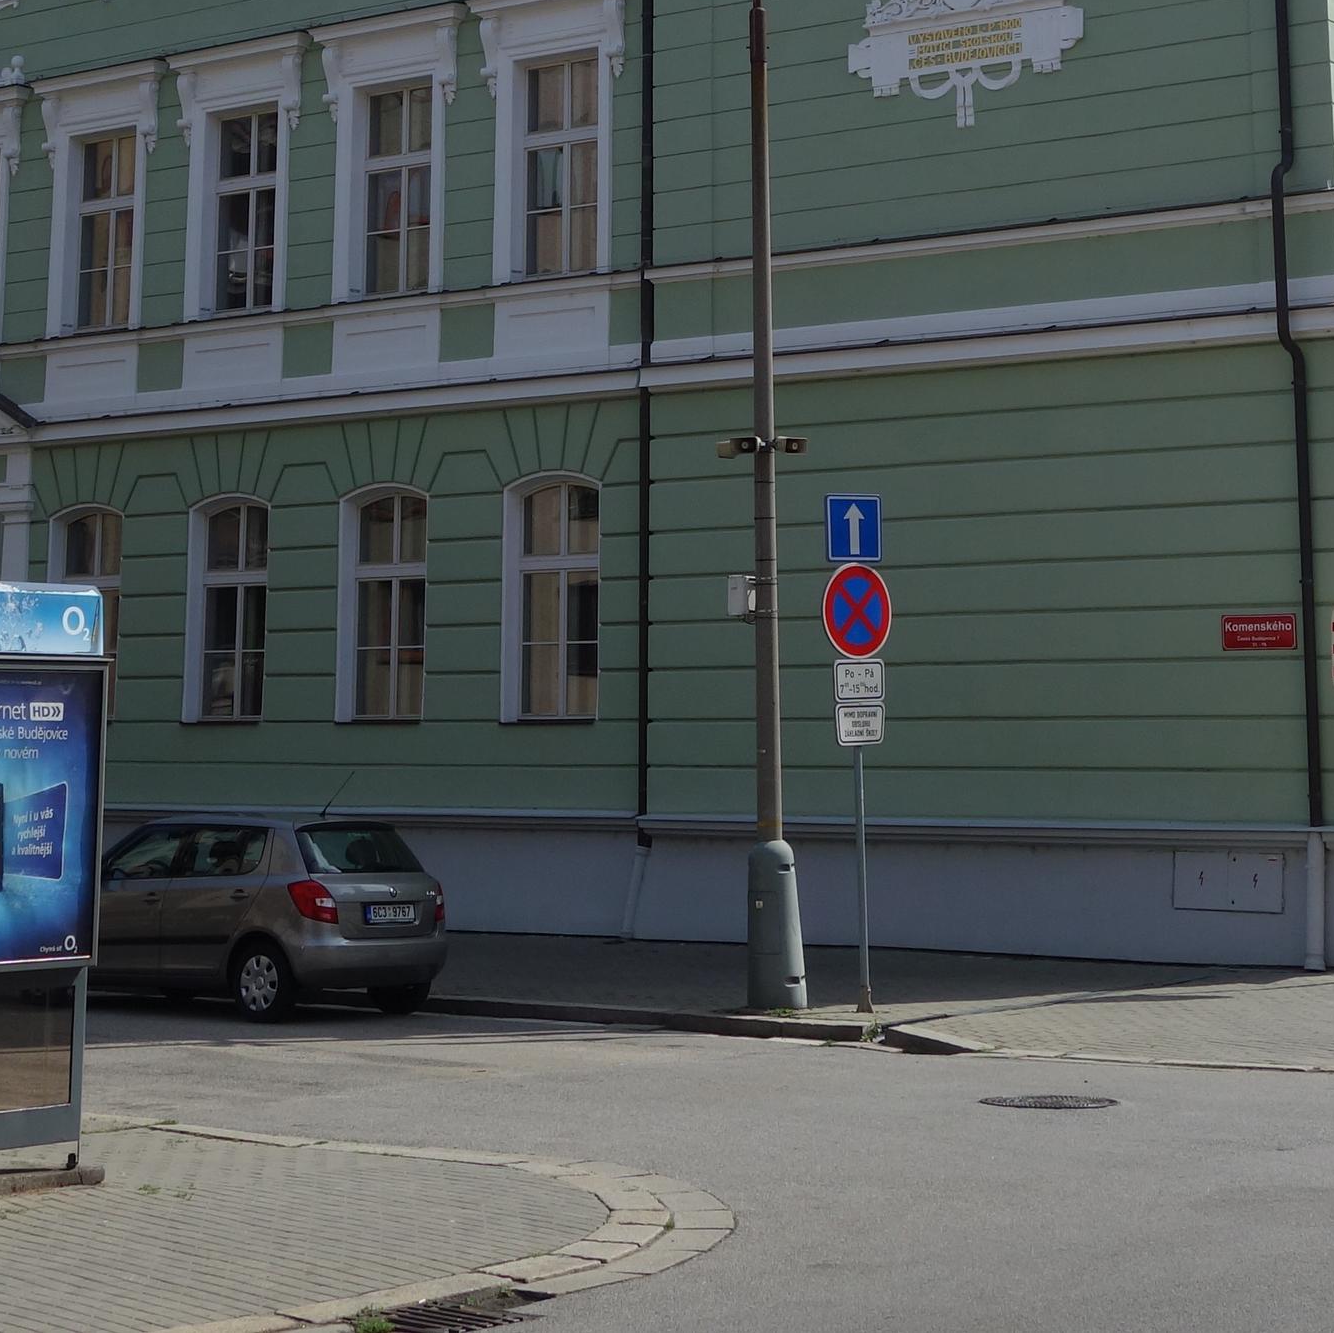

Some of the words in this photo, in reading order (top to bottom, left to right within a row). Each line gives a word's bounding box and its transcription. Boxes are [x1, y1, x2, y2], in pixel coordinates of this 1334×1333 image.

[61, 606, 90, 641] O2
[1225, 620, 1292, 633] Komenského
[845, 669, 855, 678] Po
[865, 668, 874, 678] Pá
[18, 726, 68, 743] Budějovice
[3, 746, 39, 759] novém
[13, 810, 28, 827] Nyní
[33, 812, 39, 821] u
[40, 806, 54, 820] vás
[17, 824, 46, 842] rychlejší
[11, 847, 16, 855] a
[17, 841, 53, 858] kvalitnější
[372, 906, 387, 918] 6C3
[392, 906, 411, 917] 9767
[64, 934, 78, 954] O2
